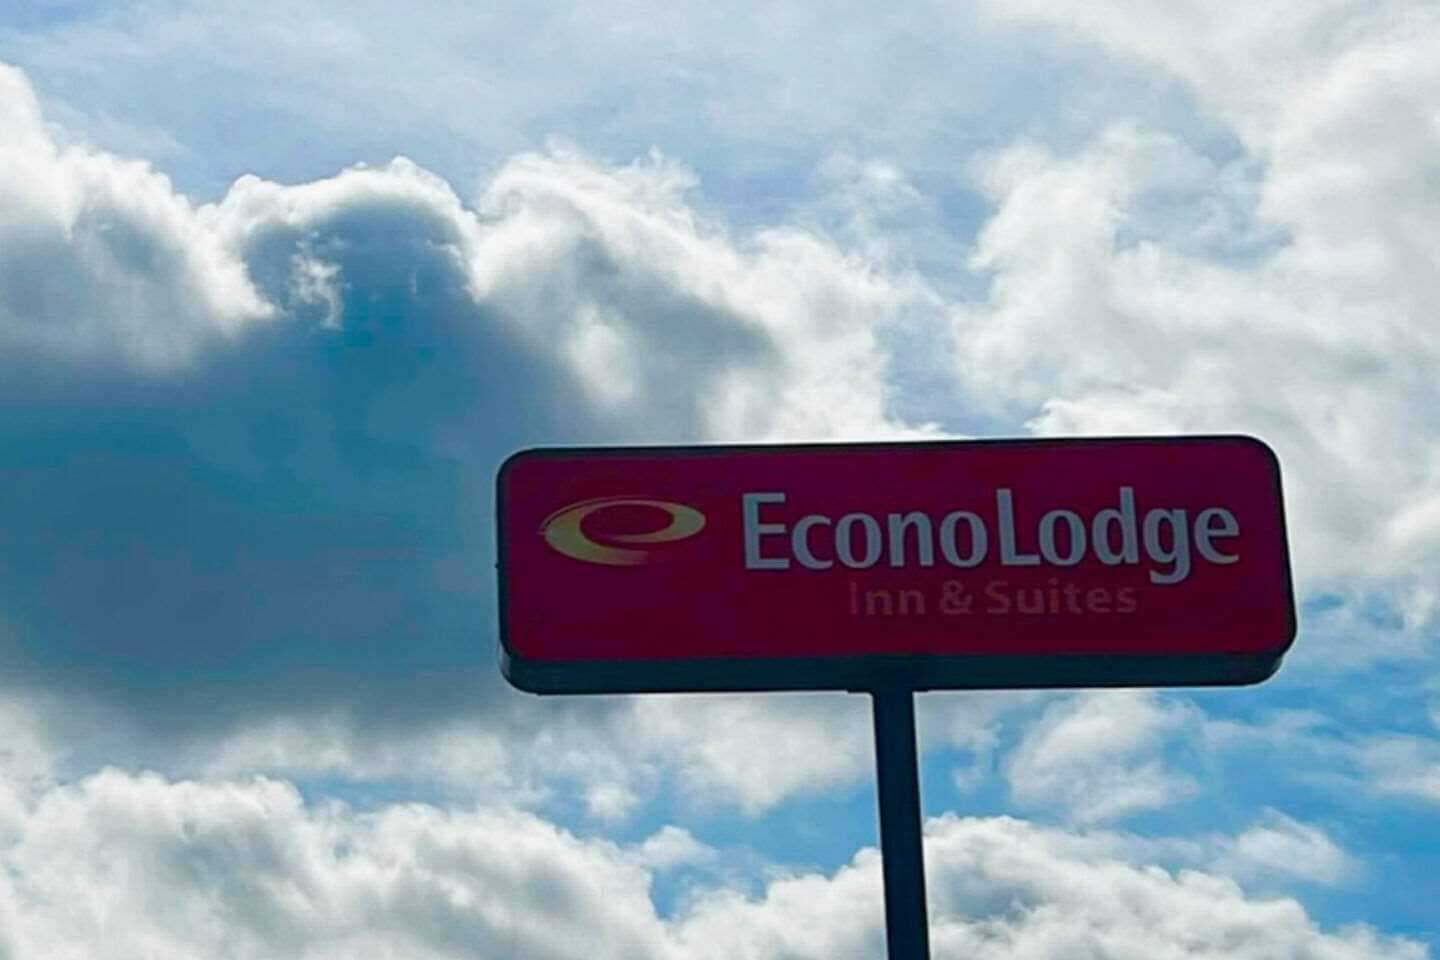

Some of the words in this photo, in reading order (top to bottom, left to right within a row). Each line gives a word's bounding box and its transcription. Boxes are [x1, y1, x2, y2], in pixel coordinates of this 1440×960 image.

[850, 582, 927, 616] Inn
[940, 580, 973, 616] &
[983, 578, 1138, 616] Suites
